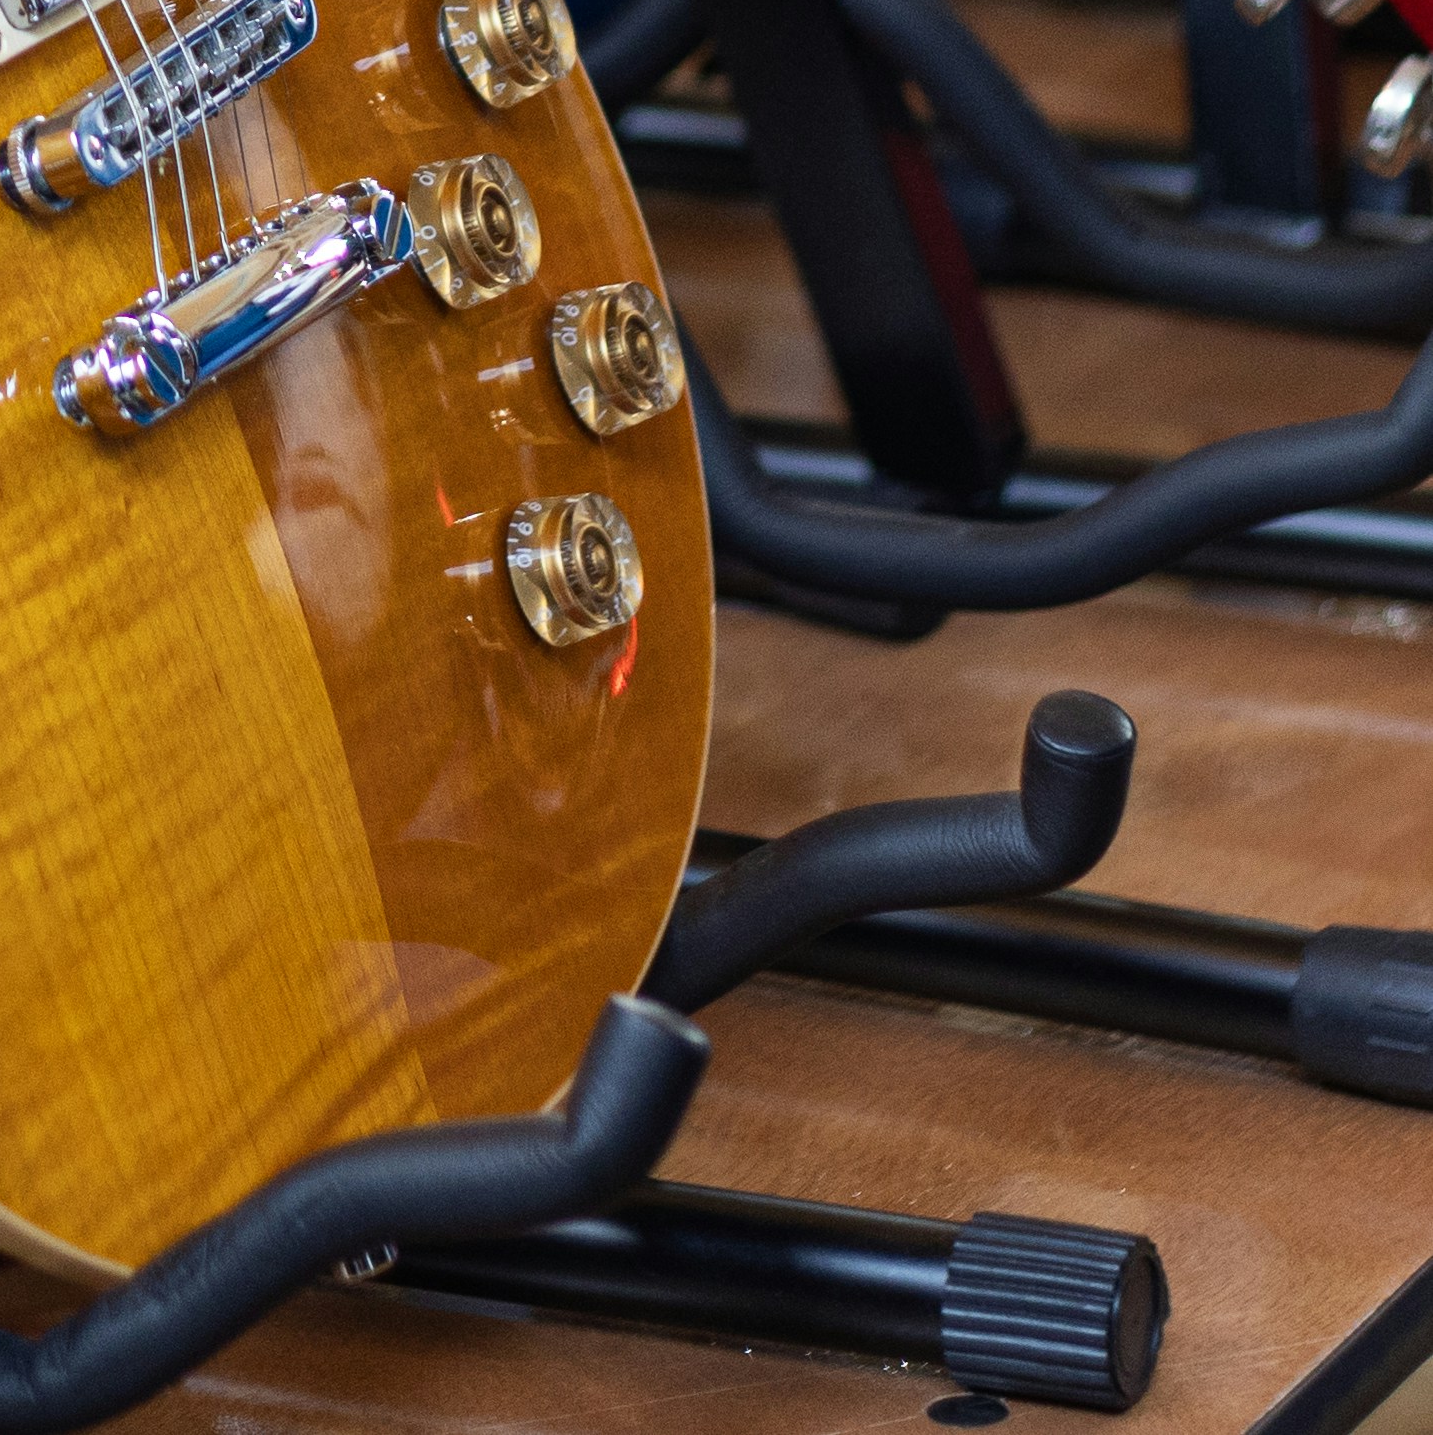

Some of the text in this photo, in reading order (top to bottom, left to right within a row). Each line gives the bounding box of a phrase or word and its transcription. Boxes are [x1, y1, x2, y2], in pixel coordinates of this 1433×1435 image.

[461, 31, 478, 47] 2
[420, 225, 437, 240] 0
[561, 326, 578, 346] 10
[515, 547, 533, 568] 10
